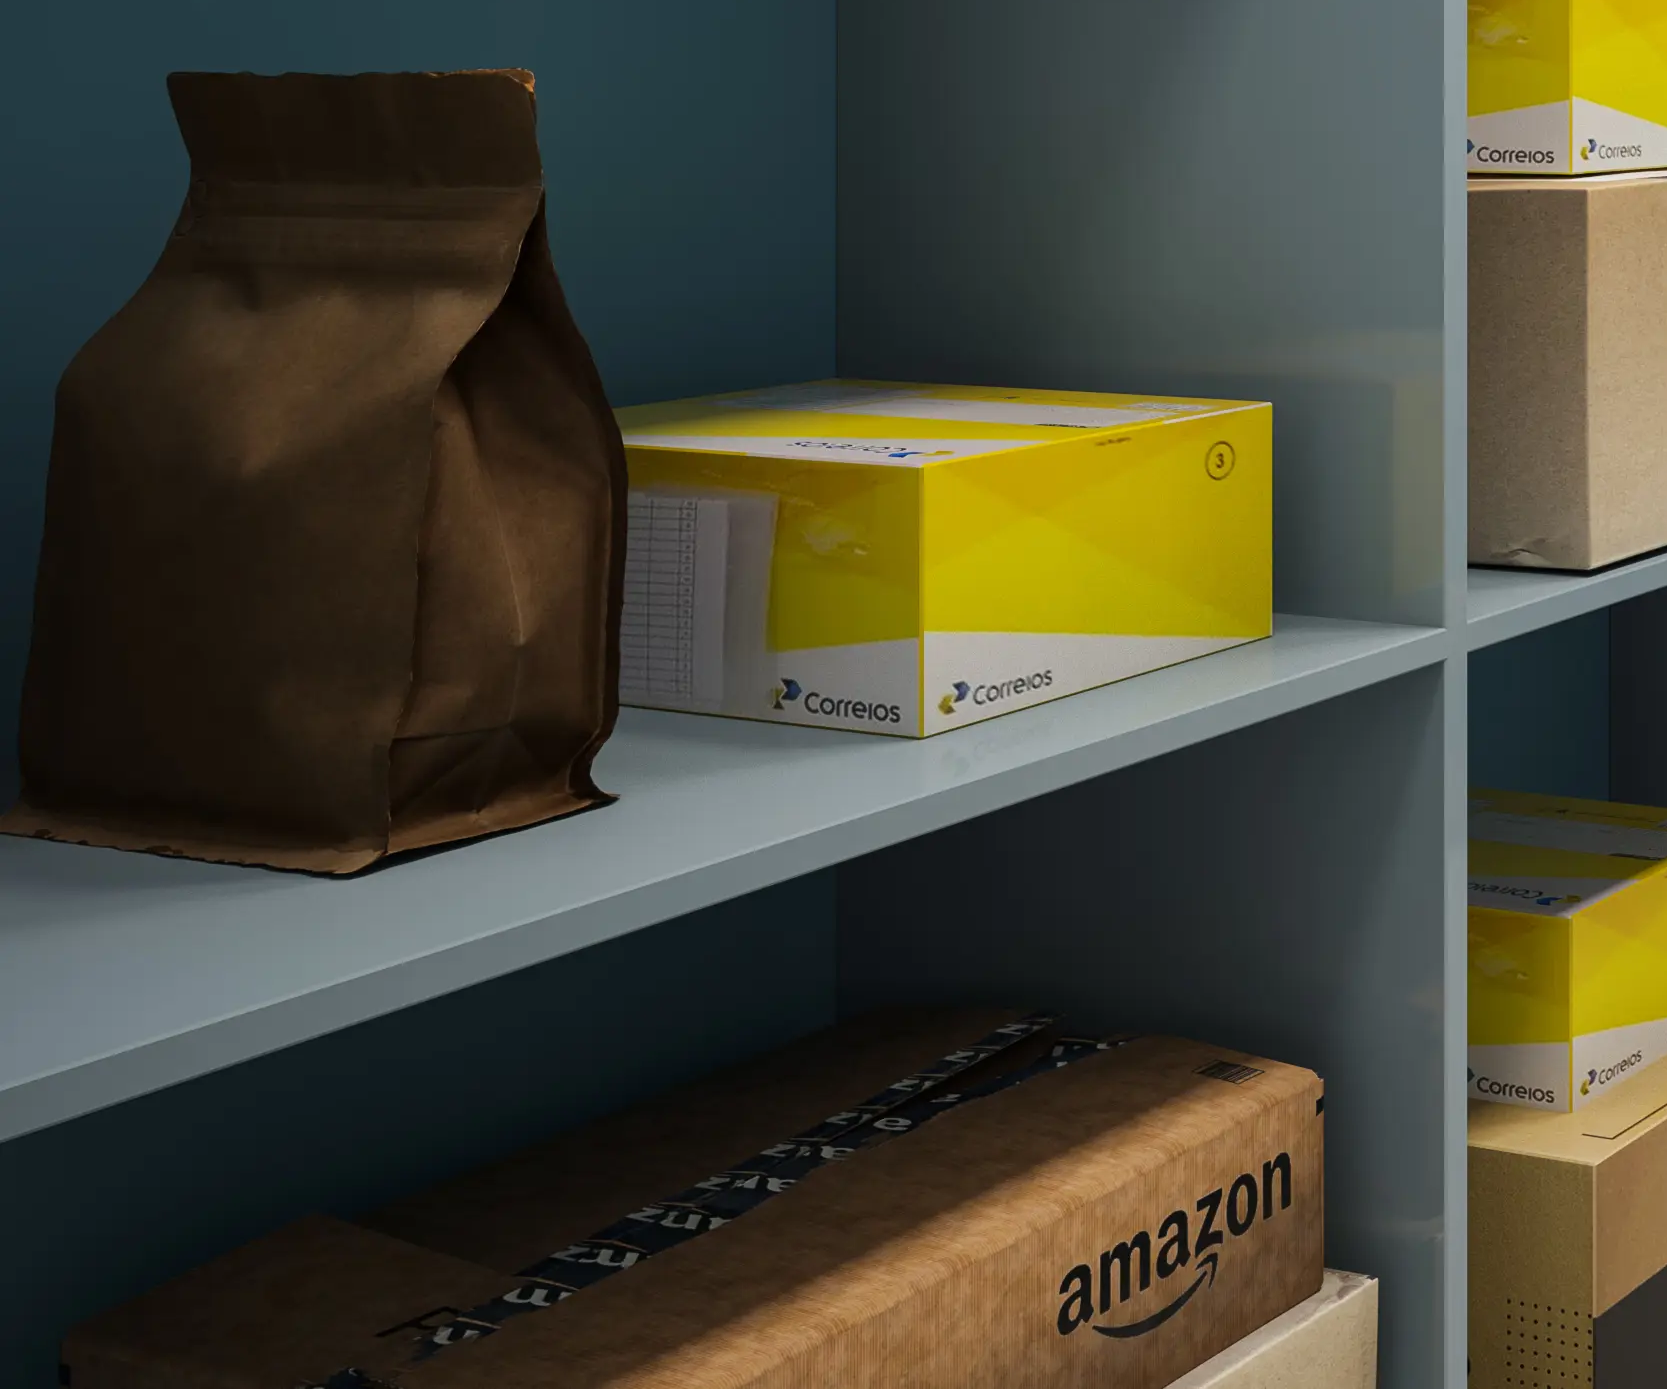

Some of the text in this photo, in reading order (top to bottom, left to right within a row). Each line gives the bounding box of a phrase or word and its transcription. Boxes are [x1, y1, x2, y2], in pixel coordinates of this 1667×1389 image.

[1476, 146, 1555, 165] Correios
[1598, 143, 1643, 160] Correios
[1214, 452, 1225, 469] 3
[972, 668, 1053, 706] Correios
[804, 691, 902, 724] Correios
[1598, 1049, 1643, 1086] Correios
[1476, 1075, 1556, 1104] Correios
[1056, 1151, 1293, 1337] amazon
